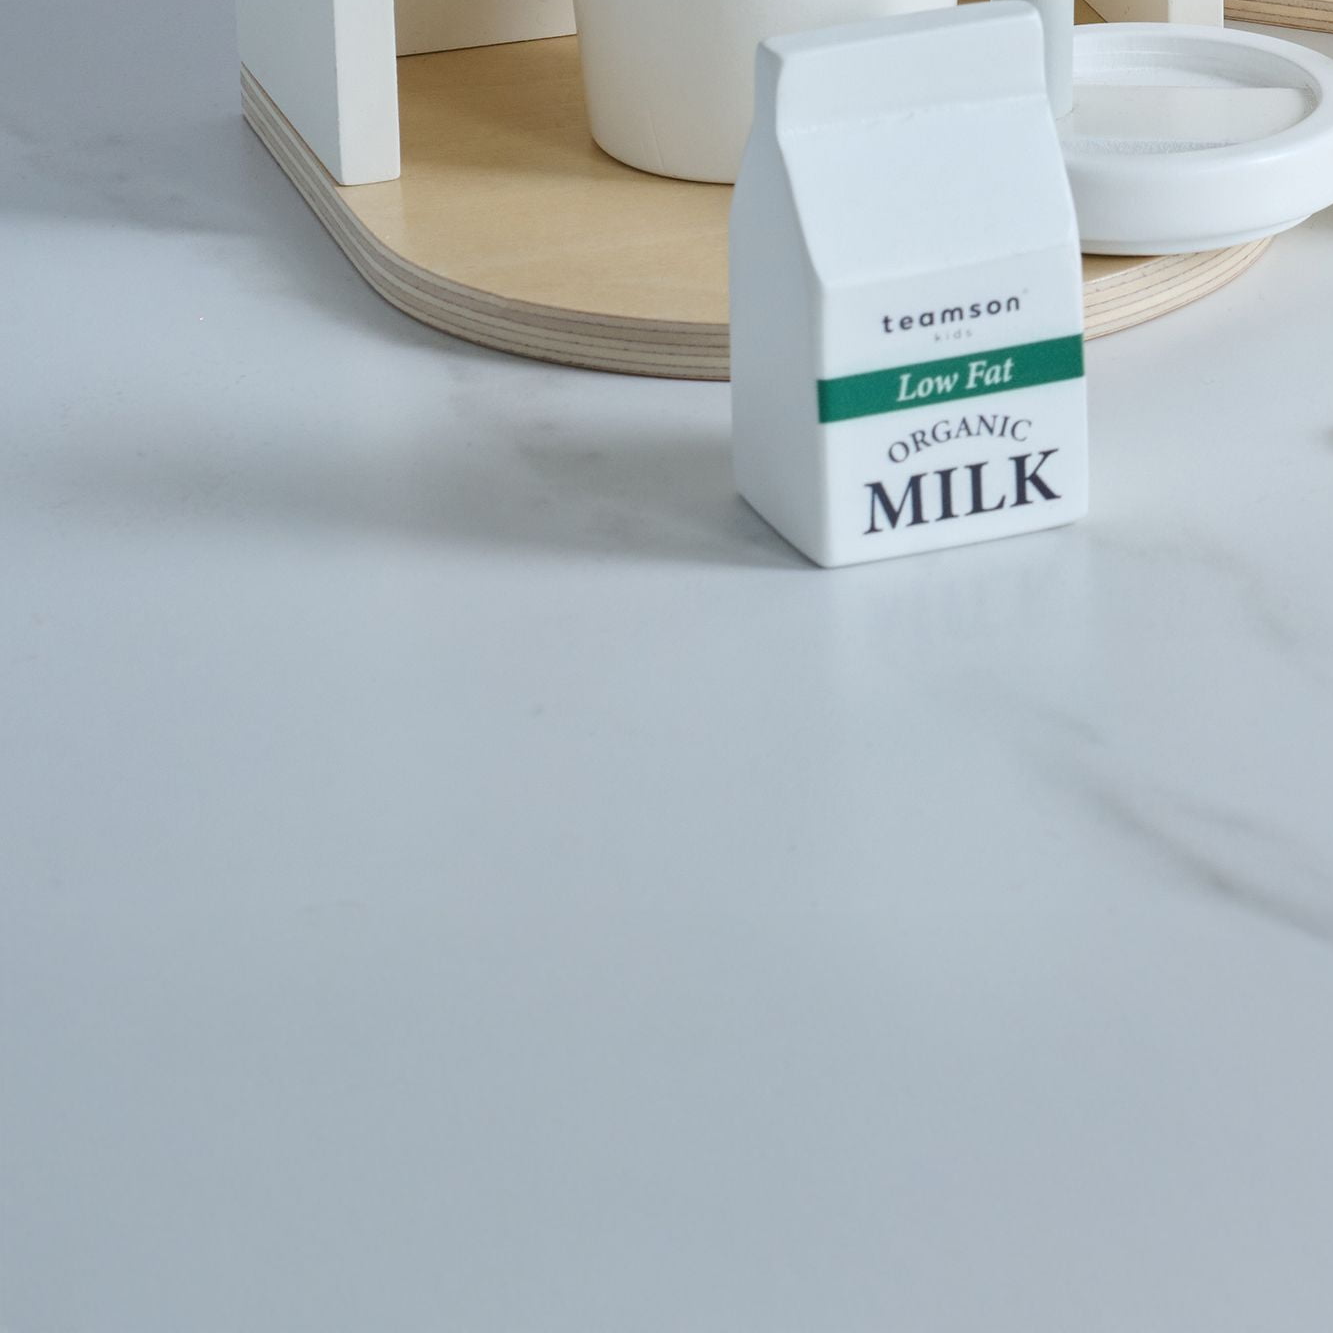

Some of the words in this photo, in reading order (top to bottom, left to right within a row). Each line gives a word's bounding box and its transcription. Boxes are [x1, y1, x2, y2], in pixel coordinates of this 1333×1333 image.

[882, 294, 1022, 335] teamson
[896, 372, 958, 403] Low
[965, 356, 1015, 390] Fat
[887, 413, 1033, 464] ORGANIC
[862, 448, 1063, 536] MILK
